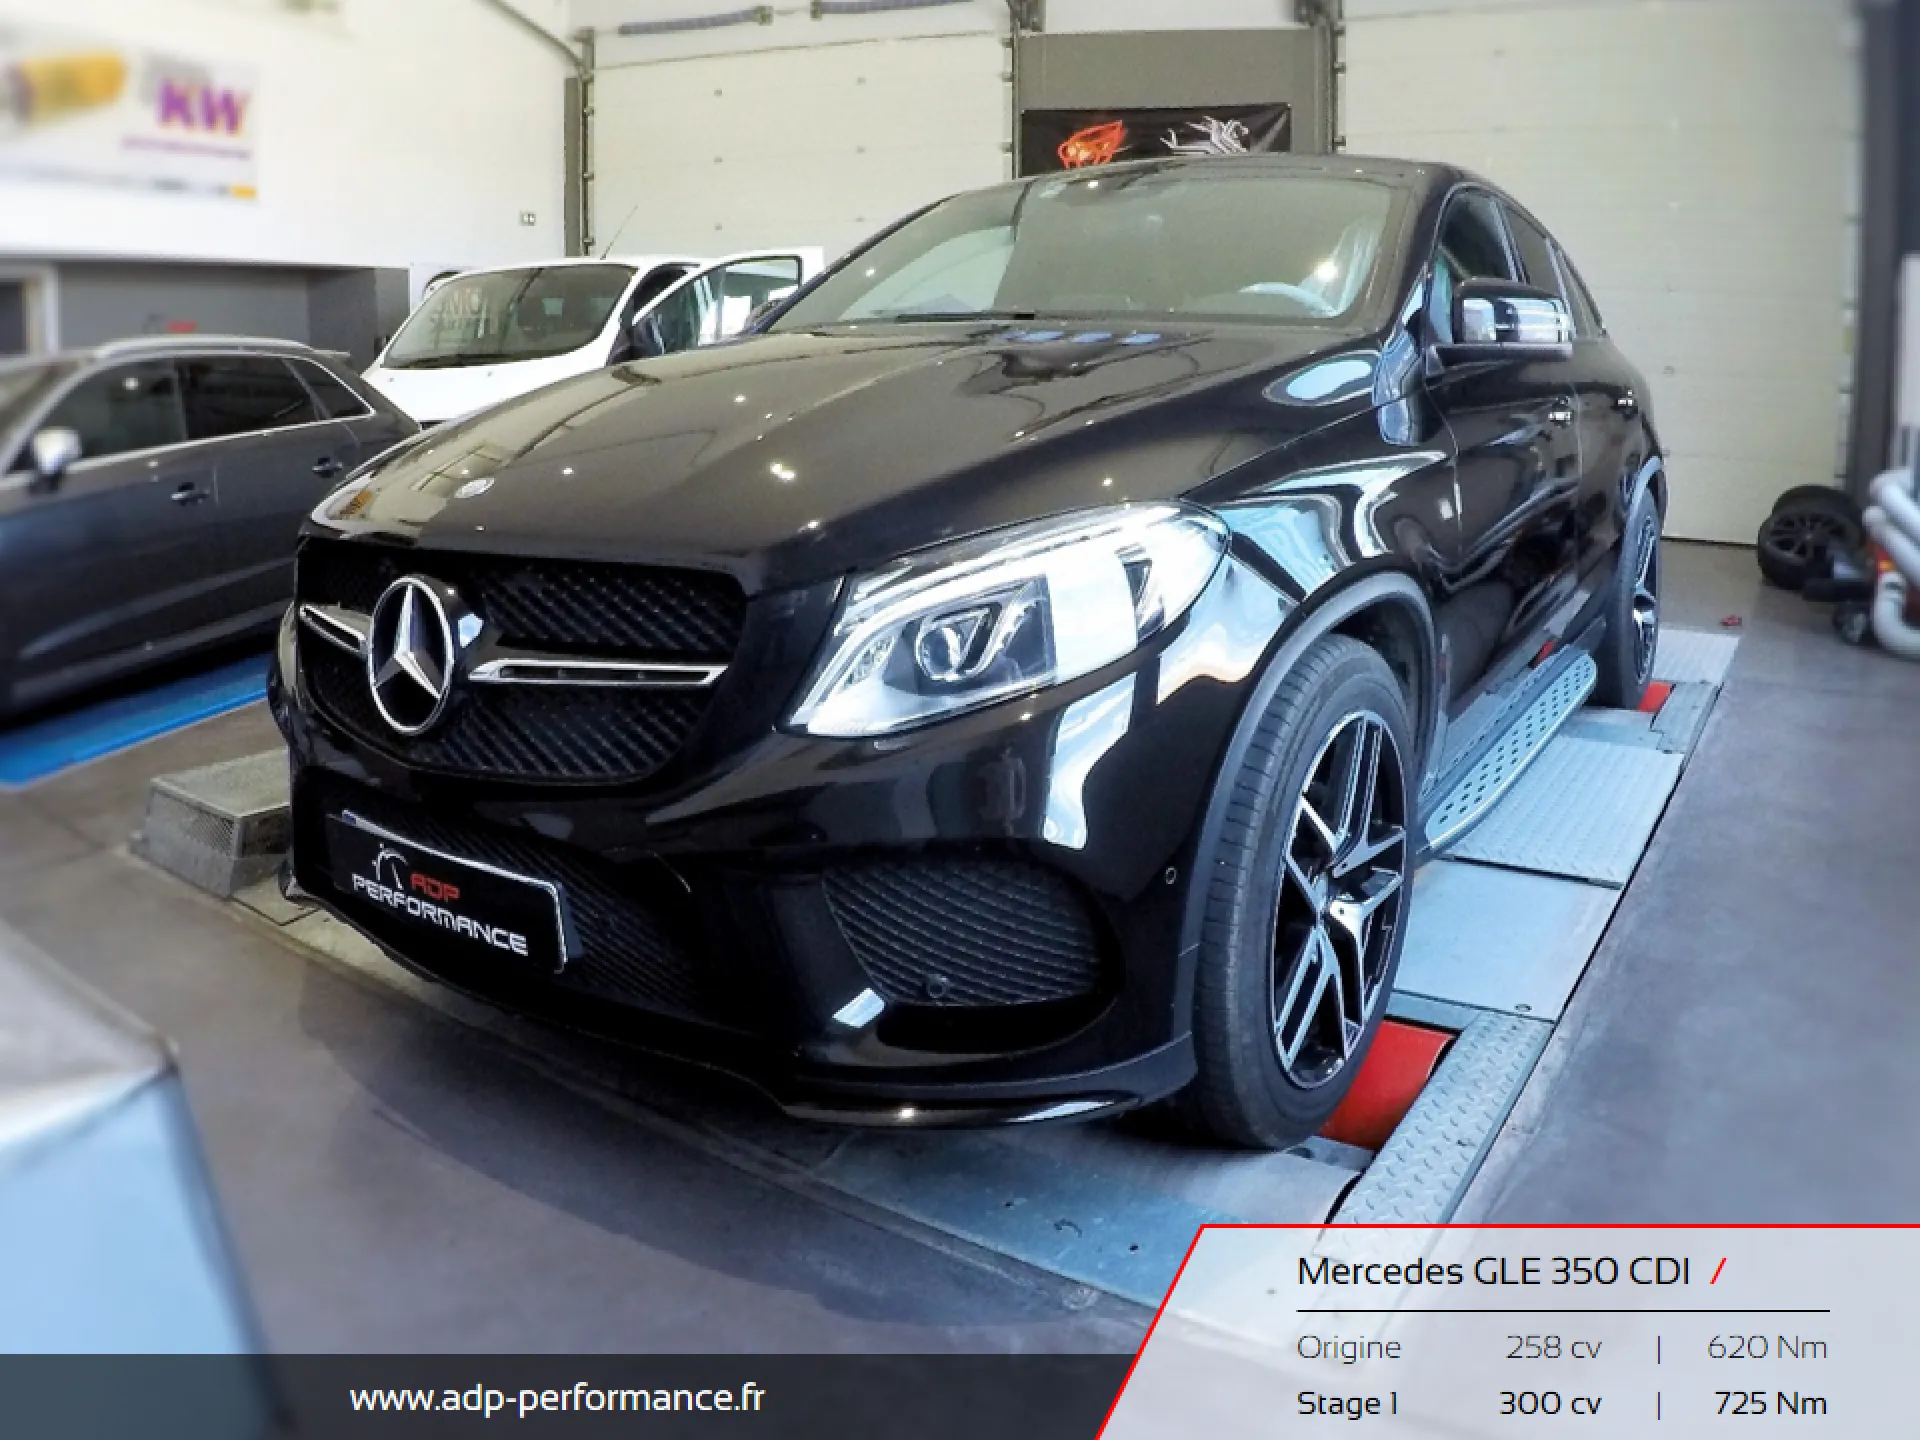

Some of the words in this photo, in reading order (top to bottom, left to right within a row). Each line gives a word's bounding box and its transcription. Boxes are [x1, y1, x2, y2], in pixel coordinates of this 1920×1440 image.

[158, 79, 252, 134] KW
[352, 874, 528, 956] PERFORMANCE
[410, 874, 460, 901] ADP
